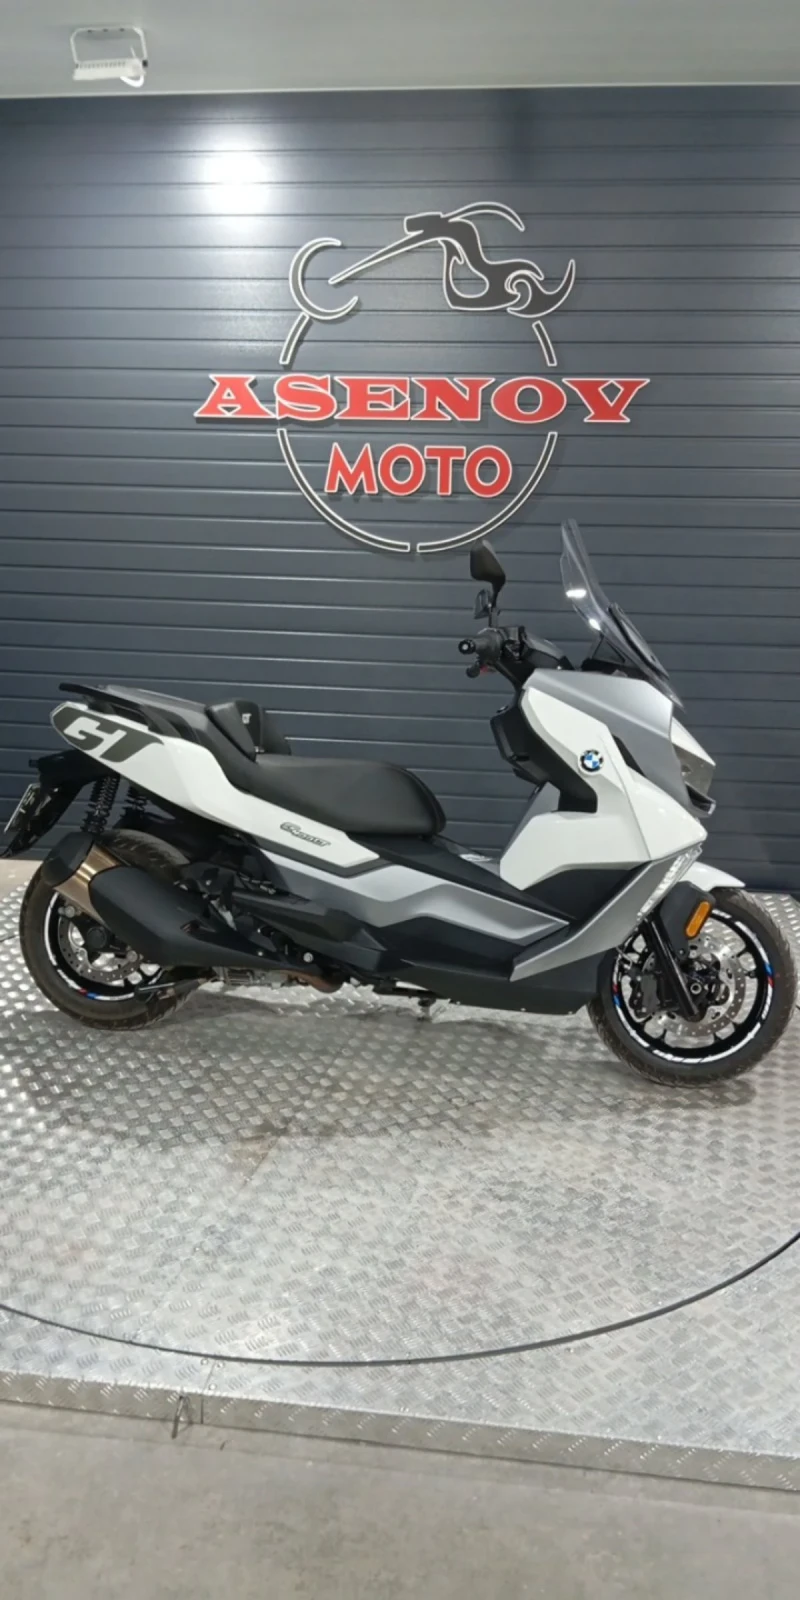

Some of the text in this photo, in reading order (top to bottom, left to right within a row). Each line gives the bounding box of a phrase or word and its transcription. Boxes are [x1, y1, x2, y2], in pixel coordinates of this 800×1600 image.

[194, 374, 650, 423] ASENOV
[324, 442, 512, 497] MOTO
[53, 706, 163, 763] GT
